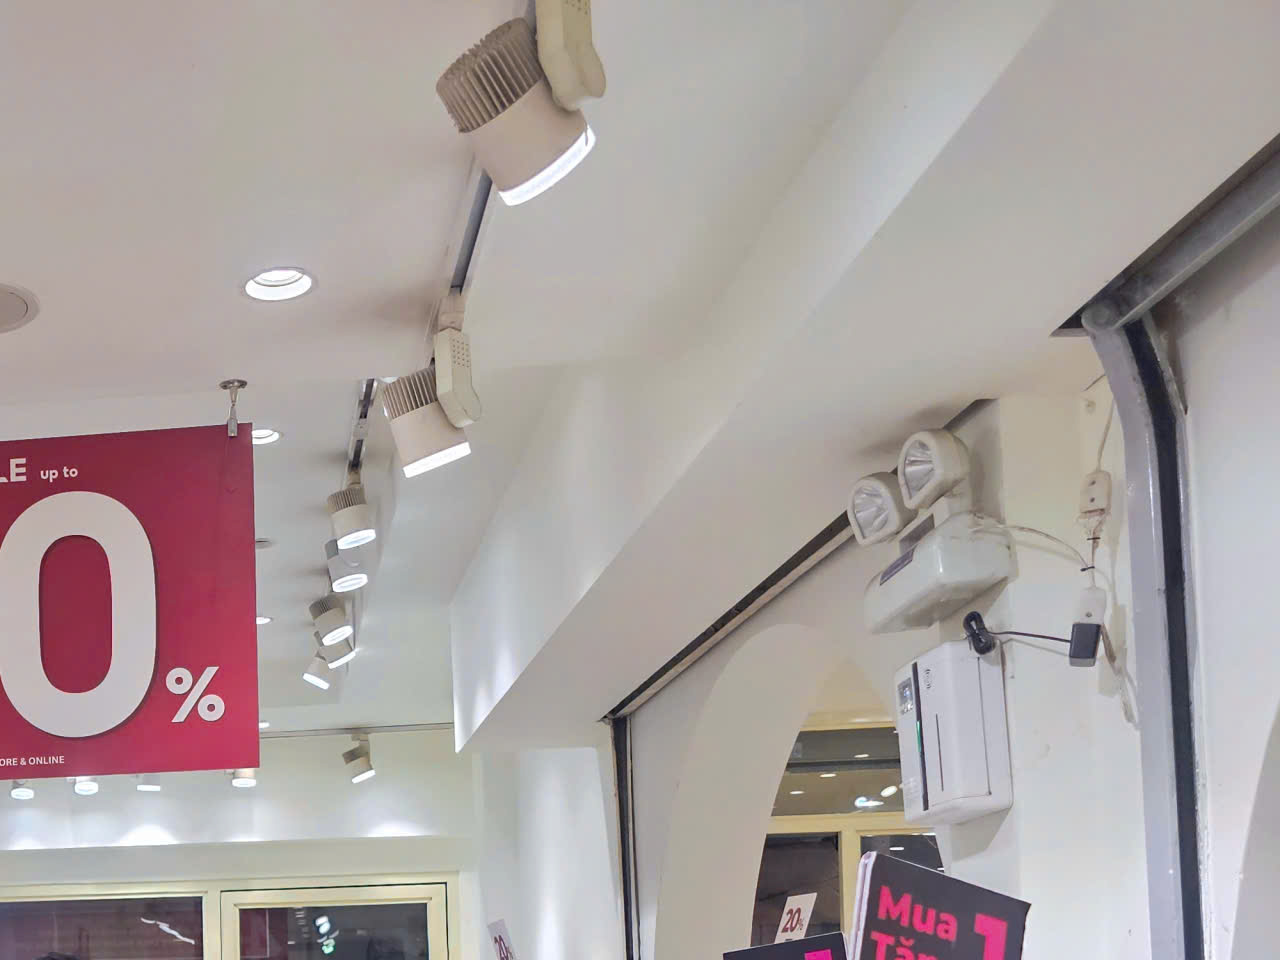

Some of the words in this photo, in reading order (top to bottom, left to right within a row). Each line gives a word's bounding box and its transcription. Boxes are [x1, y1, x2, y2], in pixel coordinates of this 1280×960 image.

[40, 469, 59, 483] up
[62, 466, 79, 478] to
[20, 757, 27, 766] &
[28, 755, 65, 766] ONLINE
[877, 885, 958, 943] Mua
